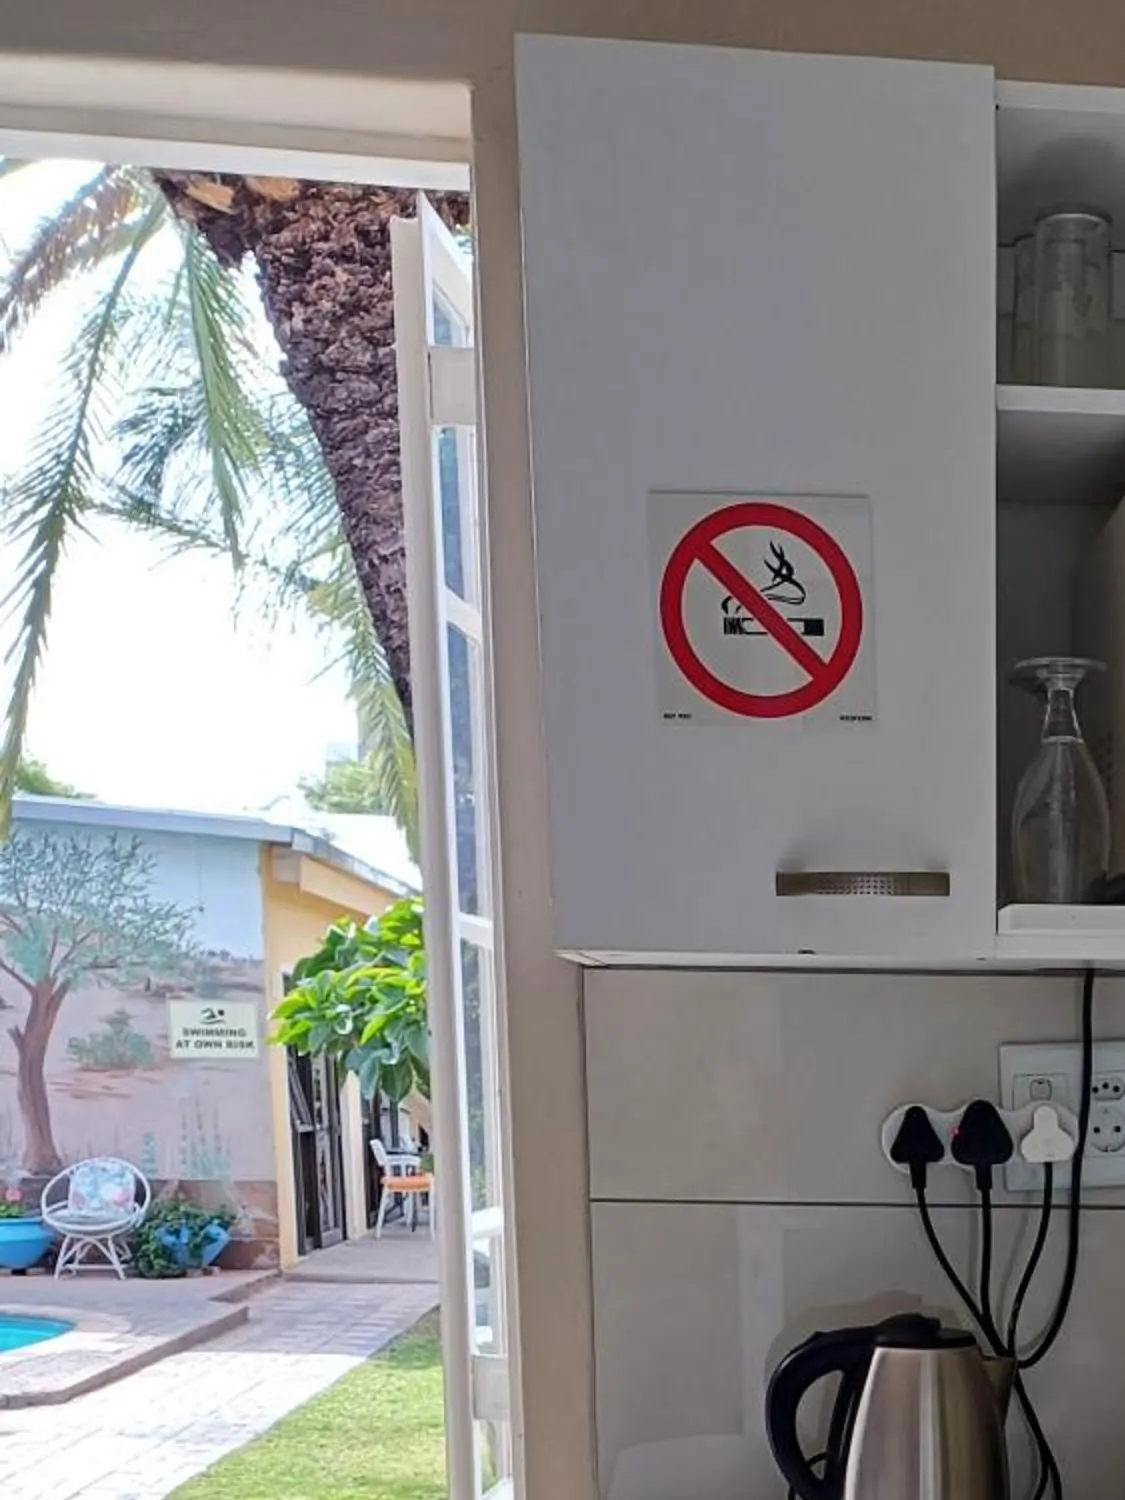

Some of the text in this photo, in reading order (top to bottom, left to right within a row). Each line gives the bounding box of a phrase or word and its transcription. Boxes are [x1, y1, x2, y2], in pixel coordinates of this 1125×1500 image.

[182, 1027, 247, 1037] SWIMMING
[176, 1040, 255, 1049] AT OWN RISK
